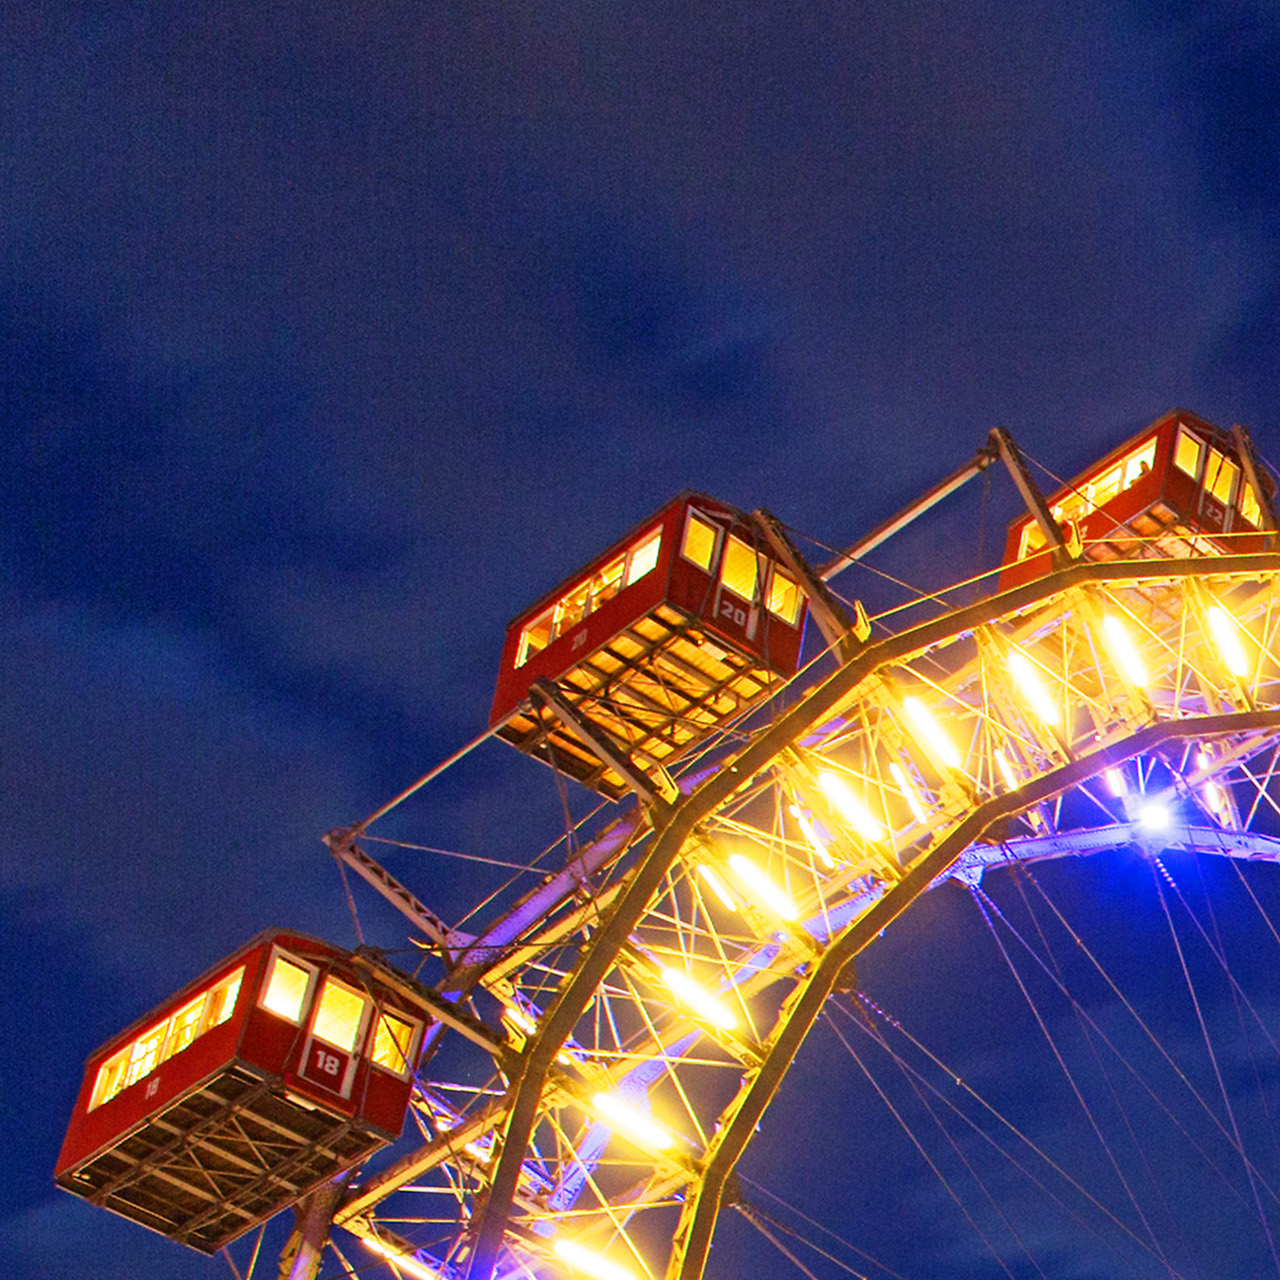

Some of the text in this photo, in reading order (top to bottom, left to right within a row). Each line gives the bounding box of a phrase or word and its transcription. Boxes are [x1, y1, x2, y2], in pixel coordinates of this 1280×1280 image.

[1205, 501, 1223, 525] 22
[720, 599, 746, 627] 20
[316, 1049, 340, 1076] 18
[145, 1076, 161, 1100] 18
